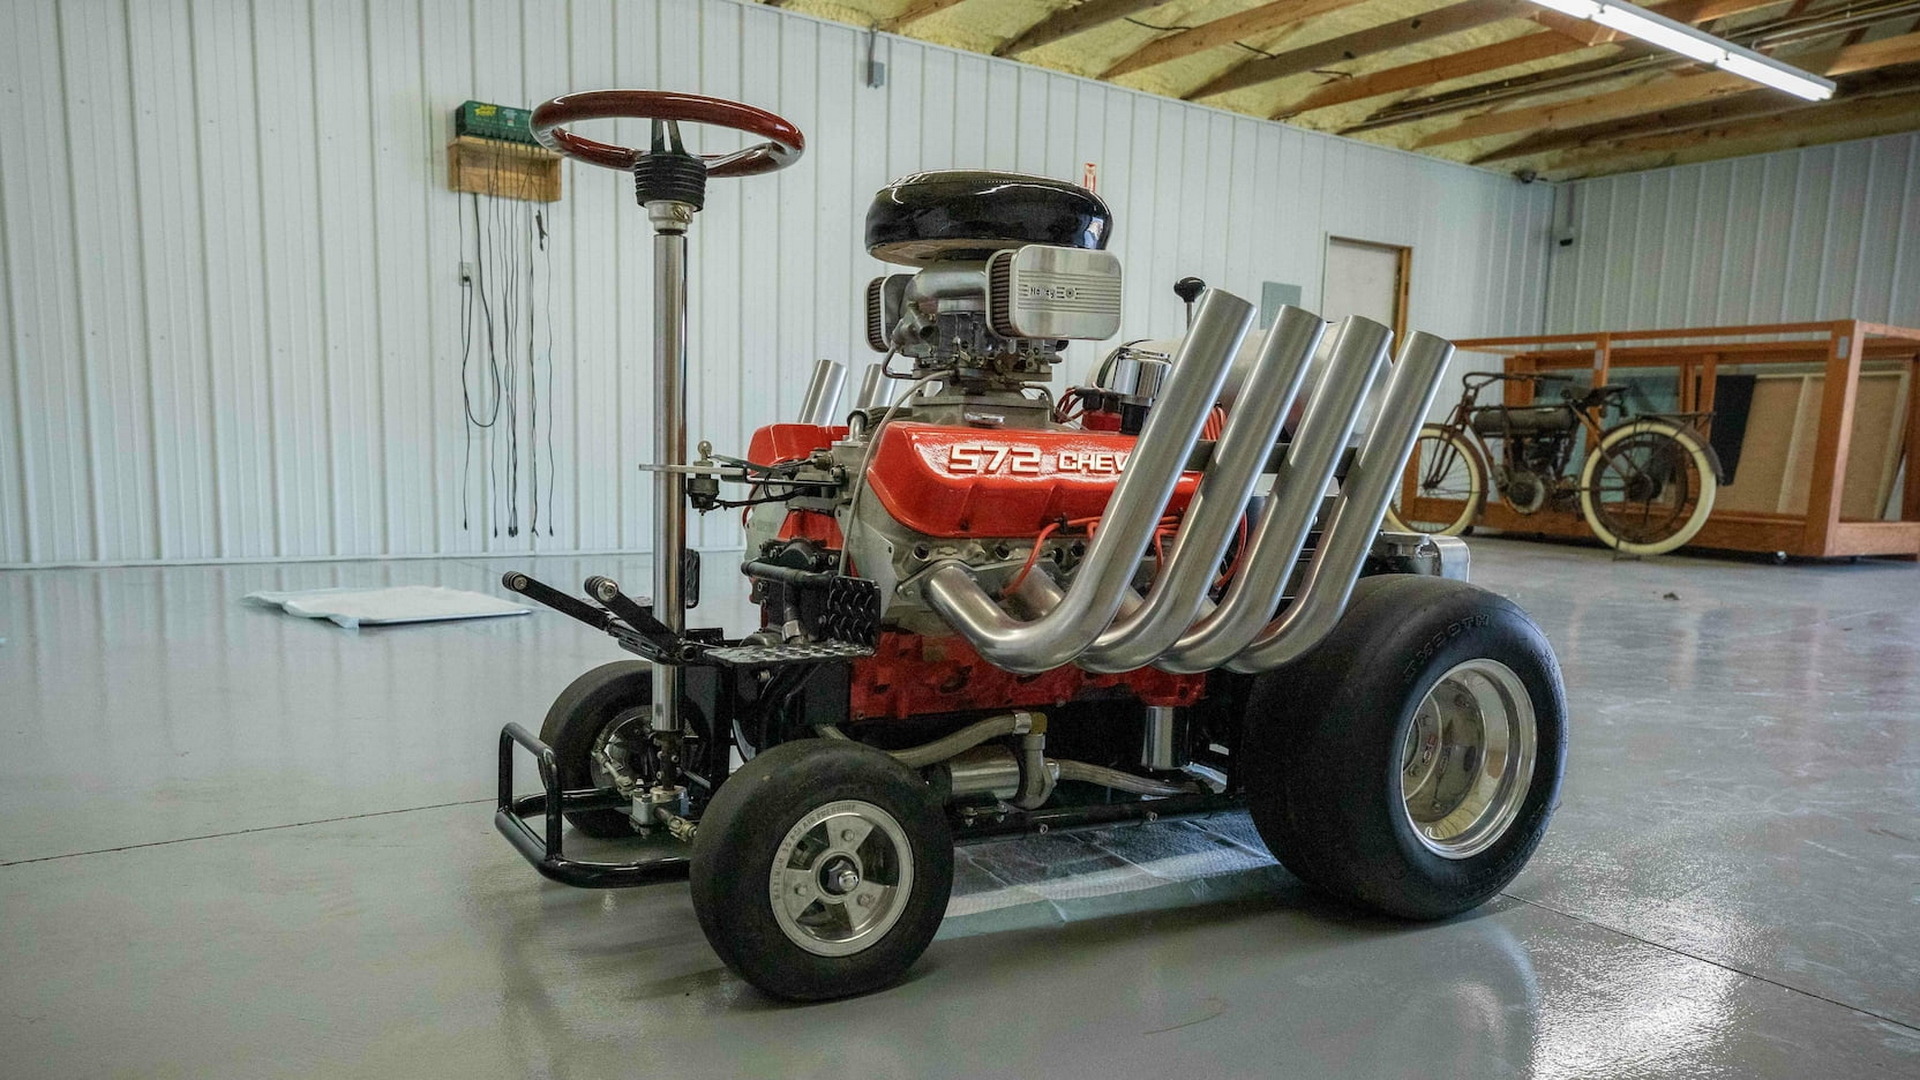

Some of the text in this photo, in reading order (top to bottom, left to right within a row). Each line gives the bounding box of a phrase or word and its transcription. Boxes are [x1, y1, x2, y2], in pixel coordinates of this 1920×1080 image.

[1029, 285, 1056, 299] Hoey
[949, 445, 1131, 474] 572 CHEV
